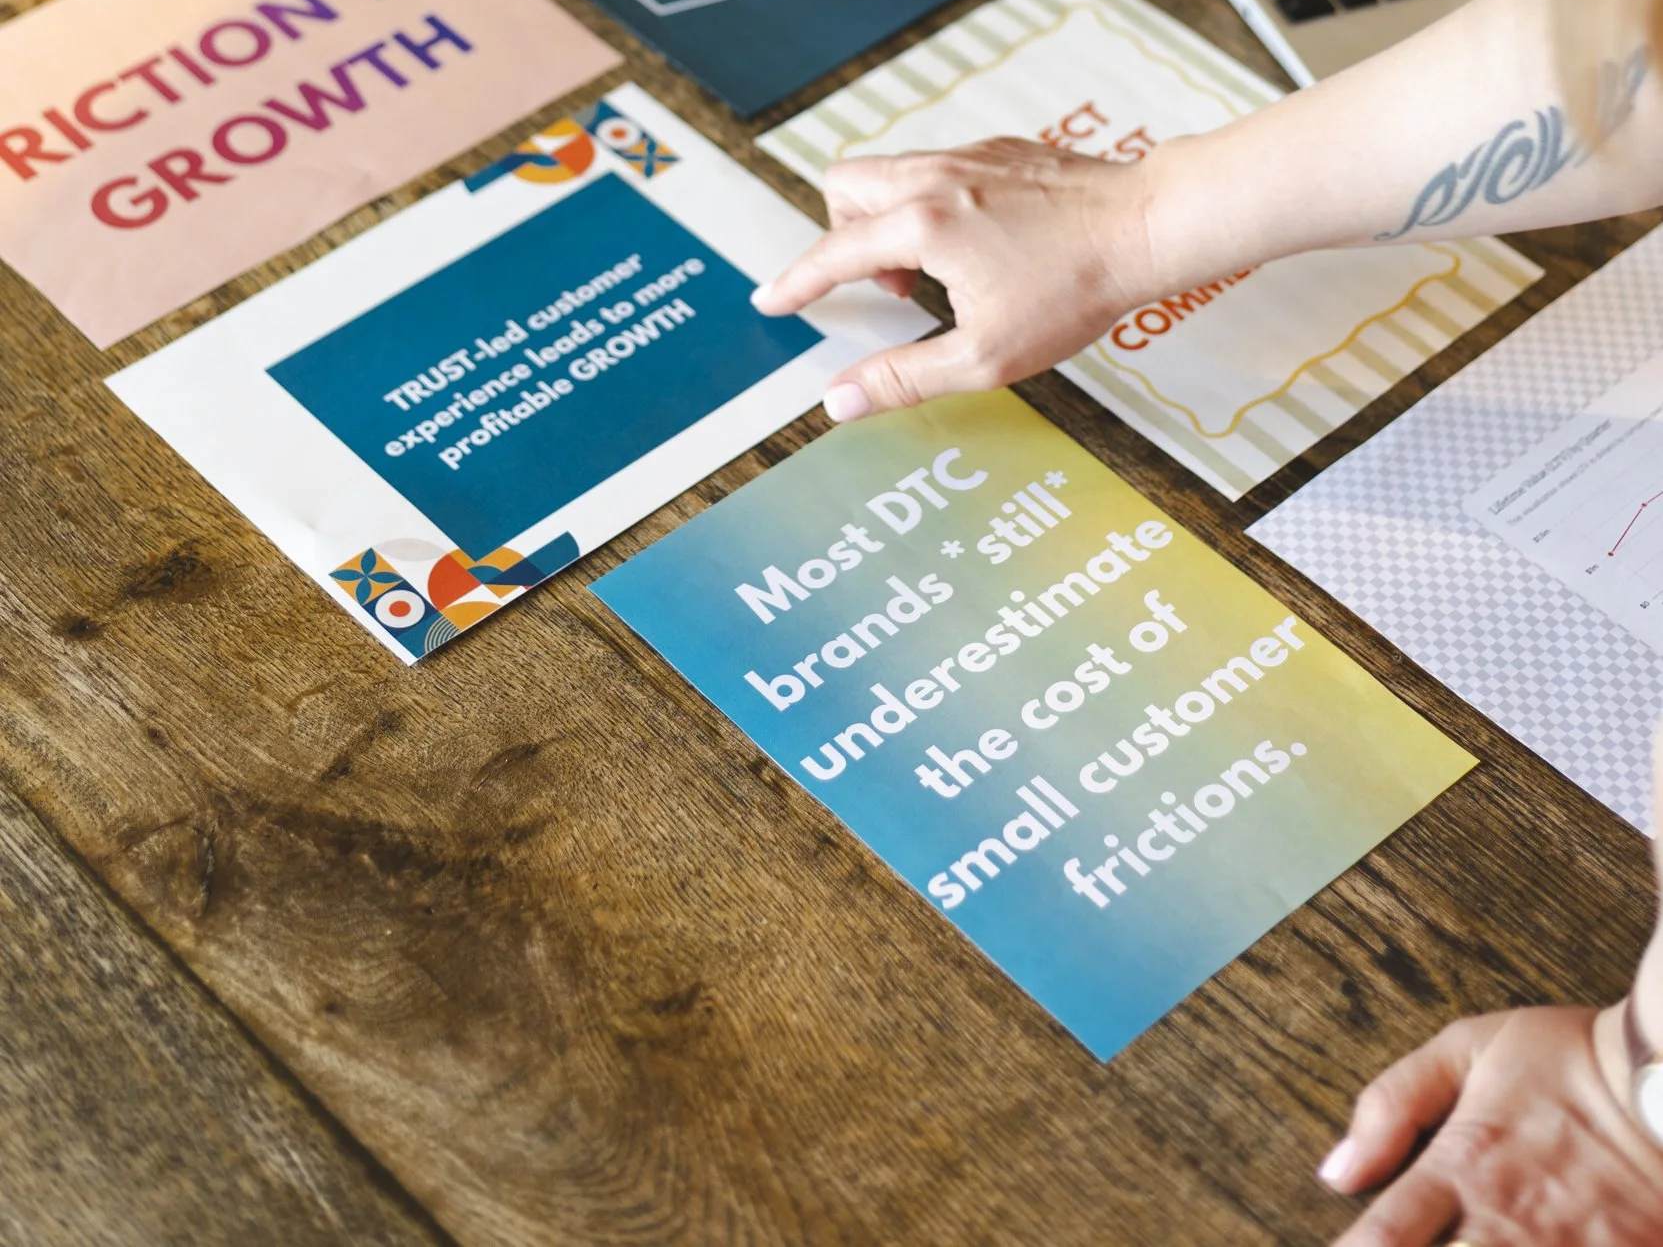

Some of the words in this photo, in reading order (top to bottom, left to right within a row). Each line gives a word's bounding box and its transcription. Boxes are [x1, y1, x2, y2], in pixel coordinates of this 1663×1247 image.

[90, 14, 474, 231] GROWTH
[1037, 100, 1110, 151] ECT
[383, 319, 529, 411] TRUST-led
[527, 253, 643, 330] customer
[384, 363, 532, 456] experience
[524, 318, 605, 368] leads
[600, 301, 636, 325] to
[633, 258, 706, 306] more
[438, 378, 575, 470] profitable
[568, 298, 697, 382] GROWTH
[734, 521, 884, 625] Most
[865, 447, 989, 536] DTC
[743, 571, 954, 712] brands
[800, 519, 1175, 782] underestimate
[914, 727, 1019, 799] the
[1020, 642, 1133, 731] cost
[1128, 589, 1189, 653] of
[926, 775, 1081, 911] small
[1078, 614, 1308, 794] customer
[1063, 741, 1308, 909] frictions.
